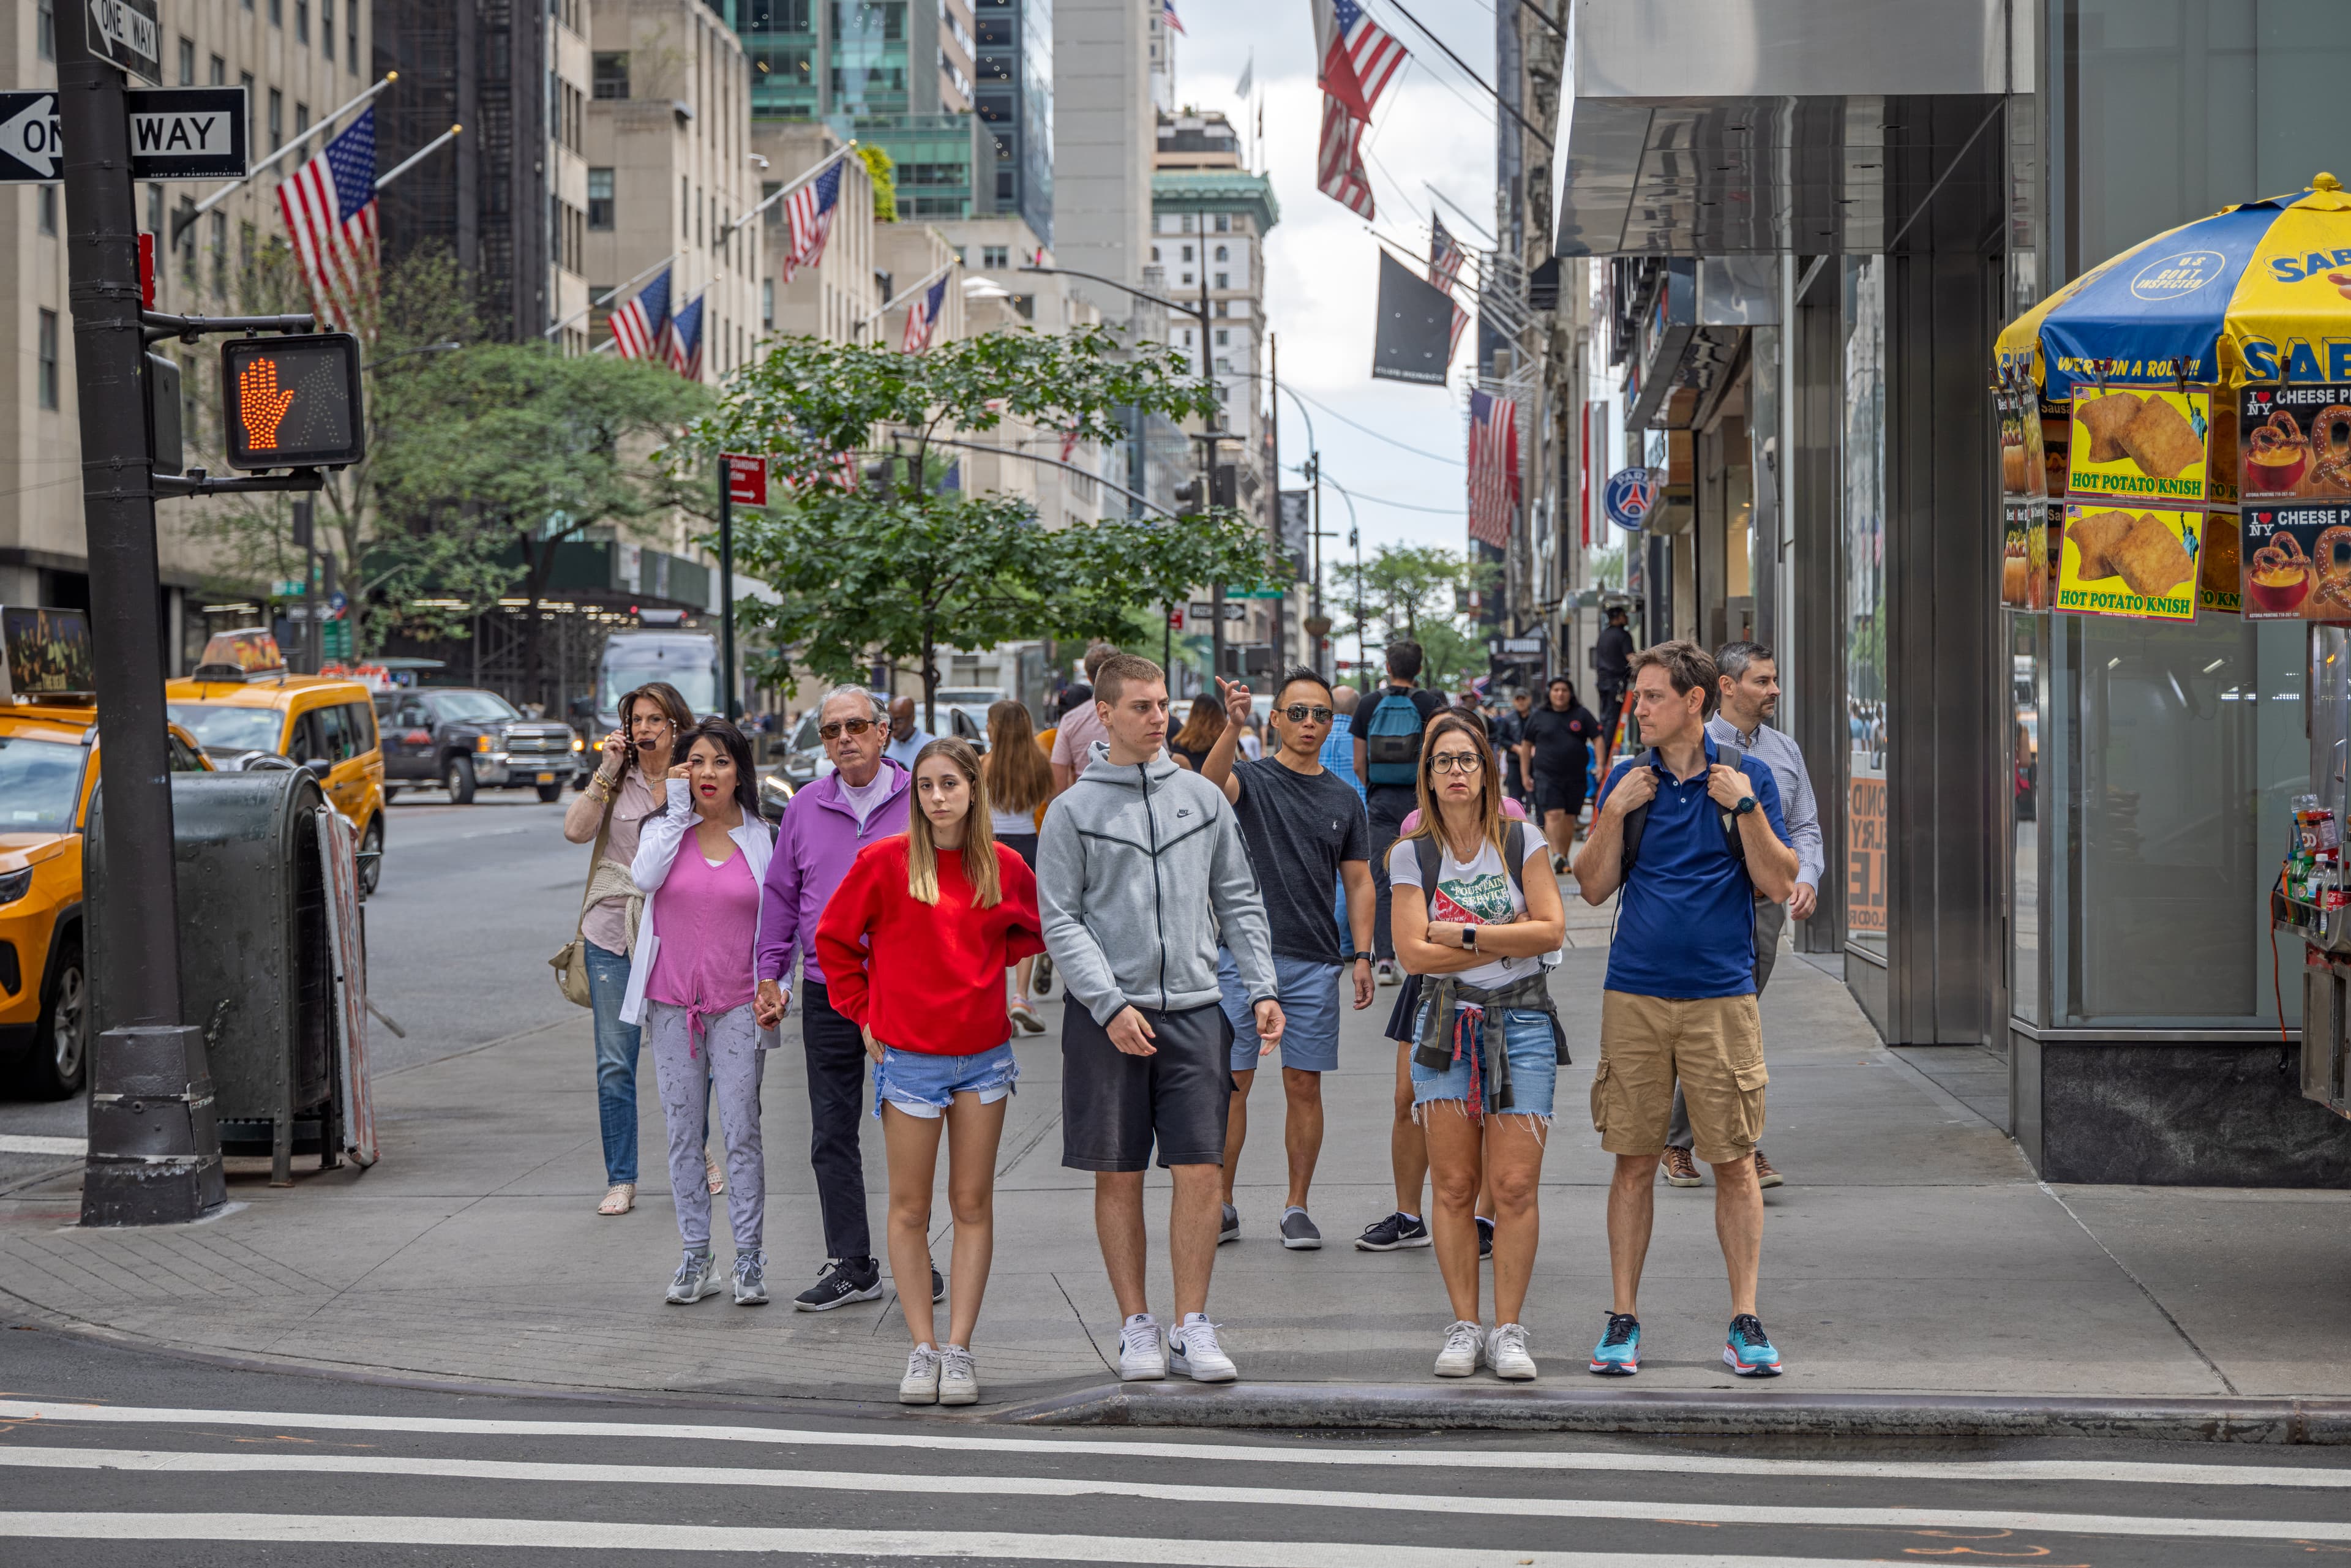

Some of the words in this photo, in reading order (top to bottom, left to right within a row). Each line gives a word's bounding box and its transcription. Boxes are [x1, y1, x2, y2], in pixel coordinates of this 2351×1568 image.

[102, 0, 123, 38] ONE
[132, 13, 152, 55] WAY
[23, 119, 63, 153] ON
[136, 116, 216, 151] WAY
[2135, 279, 2203, 289] INSPECTED
[2109, 359, 2129, 377] ON
[2131, 360, 2142, 377] A
[2276, 389, 2336, 405] CHEESE
[2339, 389, 2351, 403] P
[2247, 403, 2273, 416] NY
[2071, 472, 2100, 489] HOT
[2102, 475, 2156, 491] POTATO
[2157, 478, 2203, 497] KNISH
[2278, 510, 2337, 525] CHEESE
[2249, 523, 2275, 536] NY
[2060, 590, 2088, 607] HOT
[2089, 593, 2144, 611] POTATO
[2145, 596, 2191, 615] KNISH
[1454, 876, 1506, 896] FOUNTAIN
[1461, 887, 1508, 906] SERVICE
